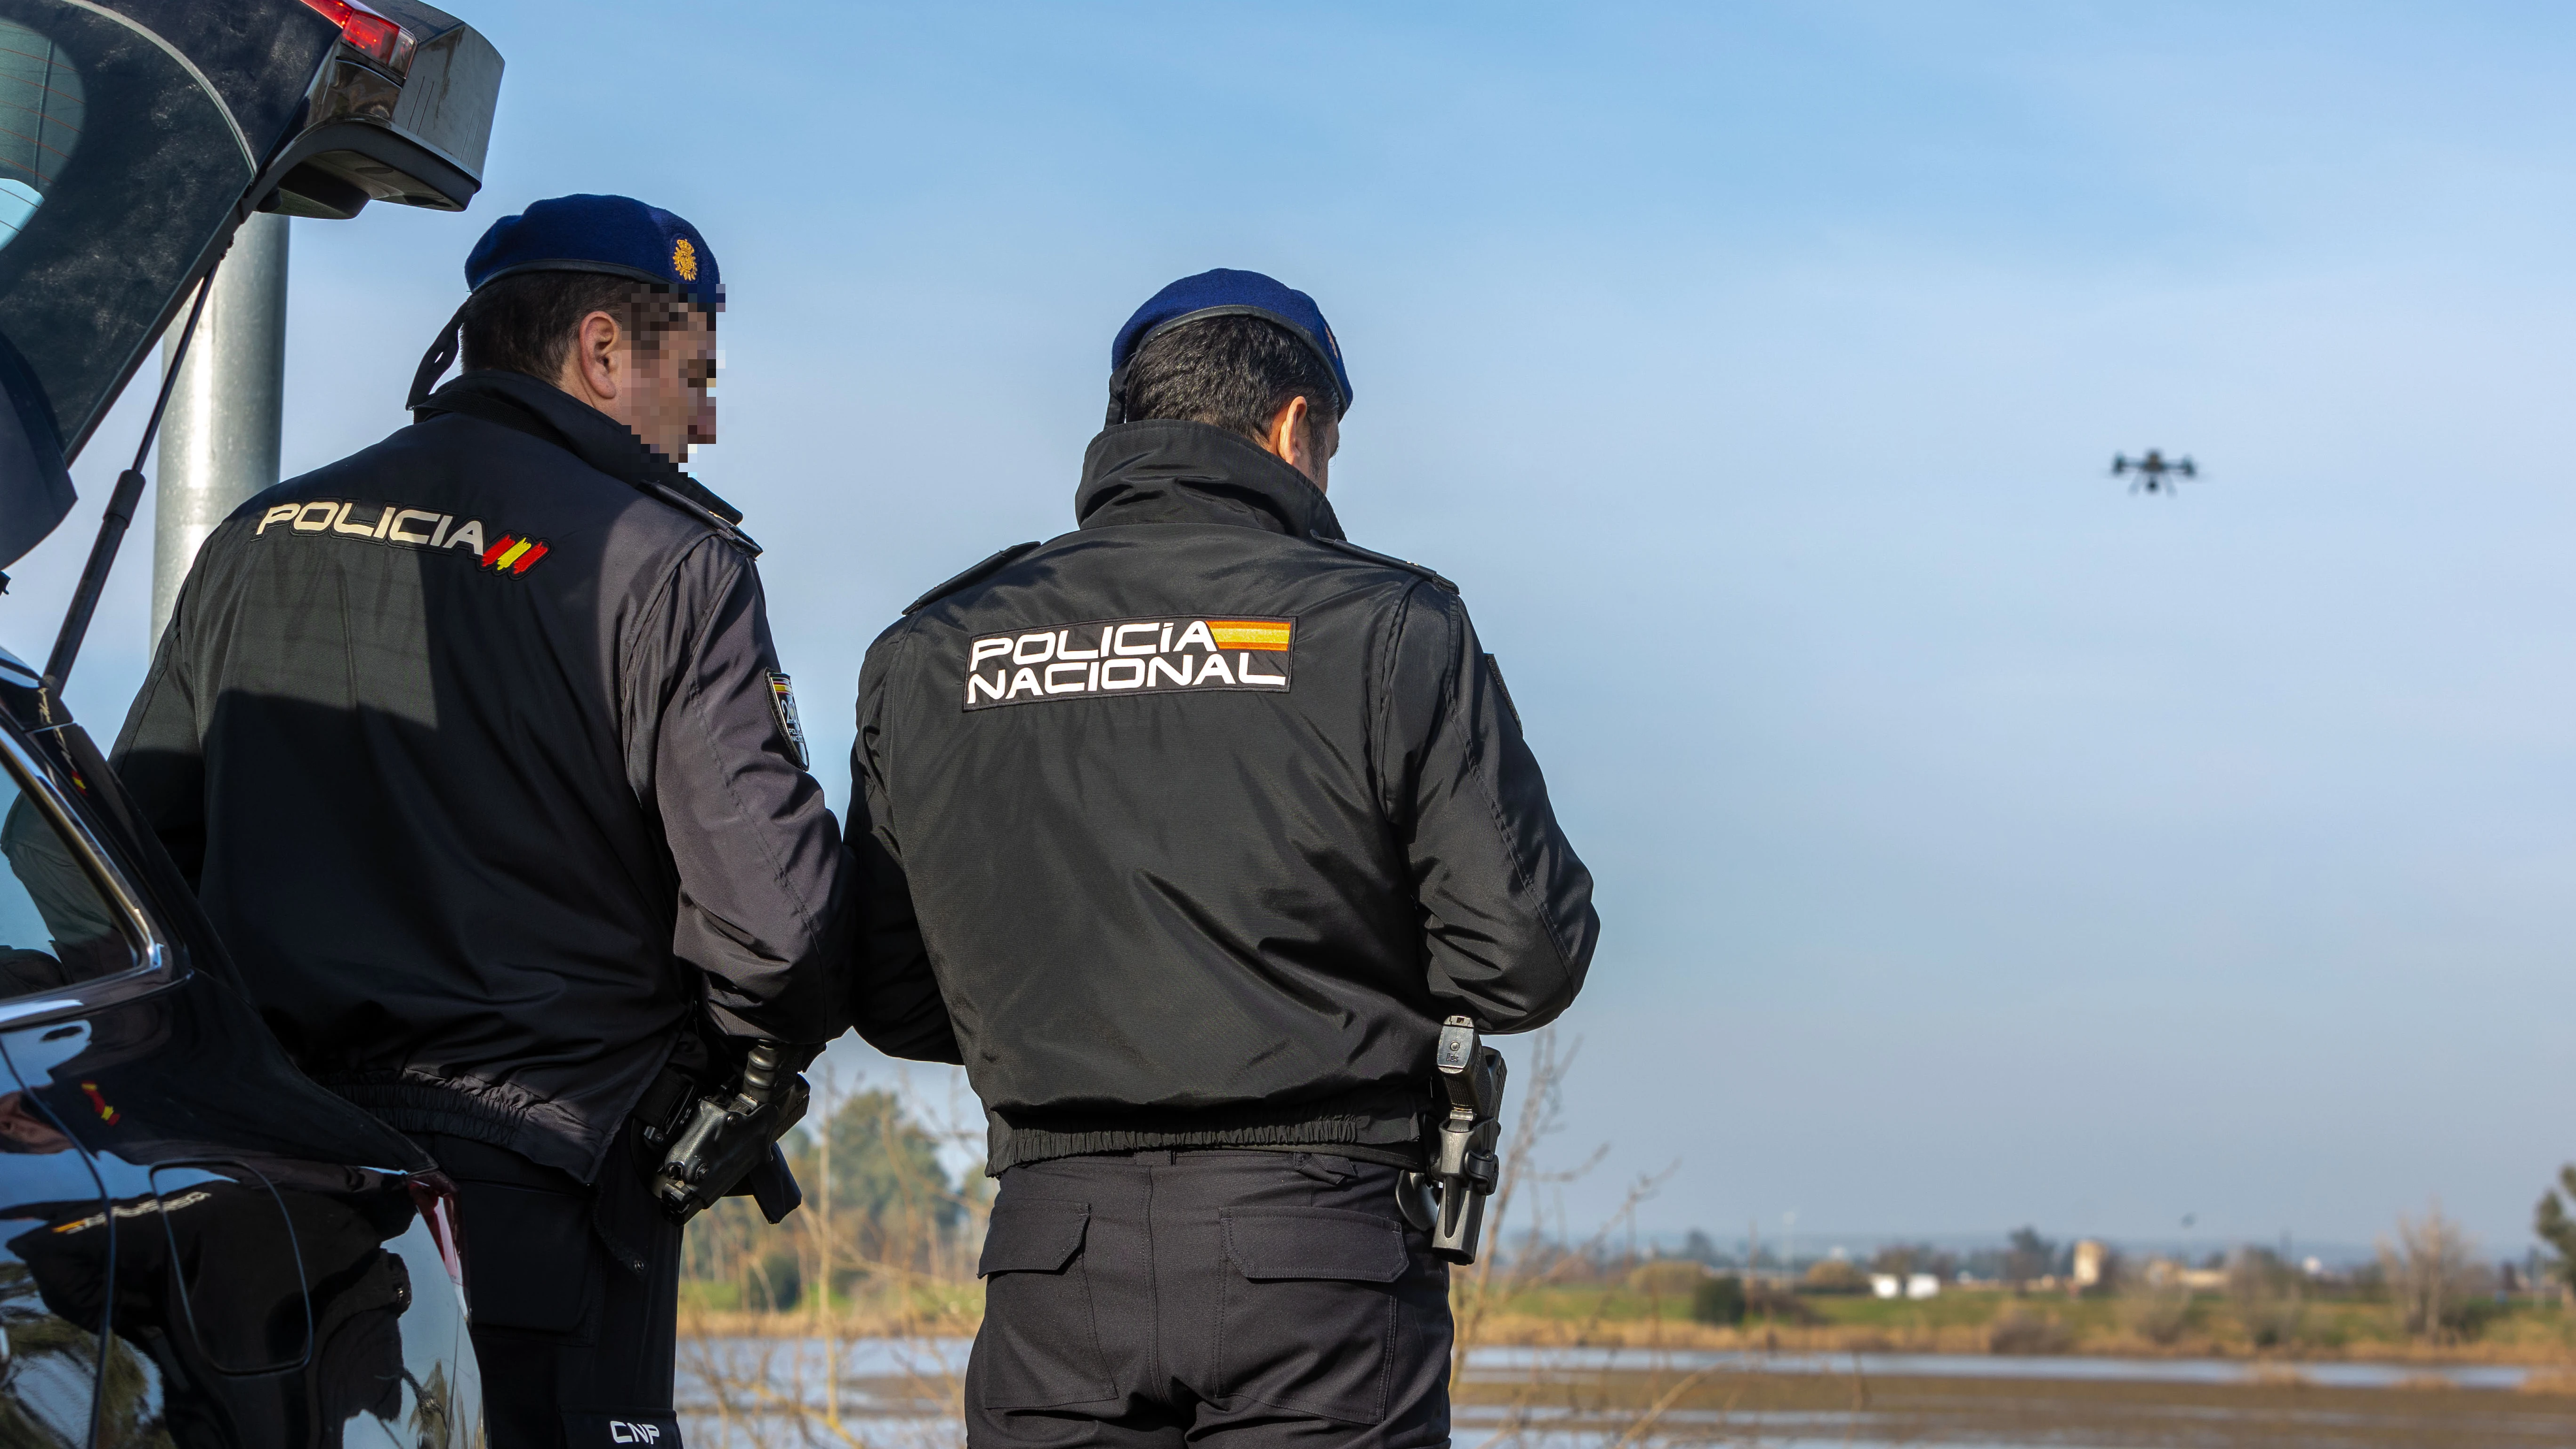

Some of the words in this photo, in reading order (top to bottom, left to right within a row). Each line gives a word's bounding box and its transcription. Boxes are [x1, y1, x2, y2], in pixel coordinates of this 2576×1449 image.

[256, 501, 483, 556] POLICIA
[967, 652, 1286, 704] NACIONAL
[781, 700, 799, 724] 20
[610, 1421, 660, 1445] CNP
